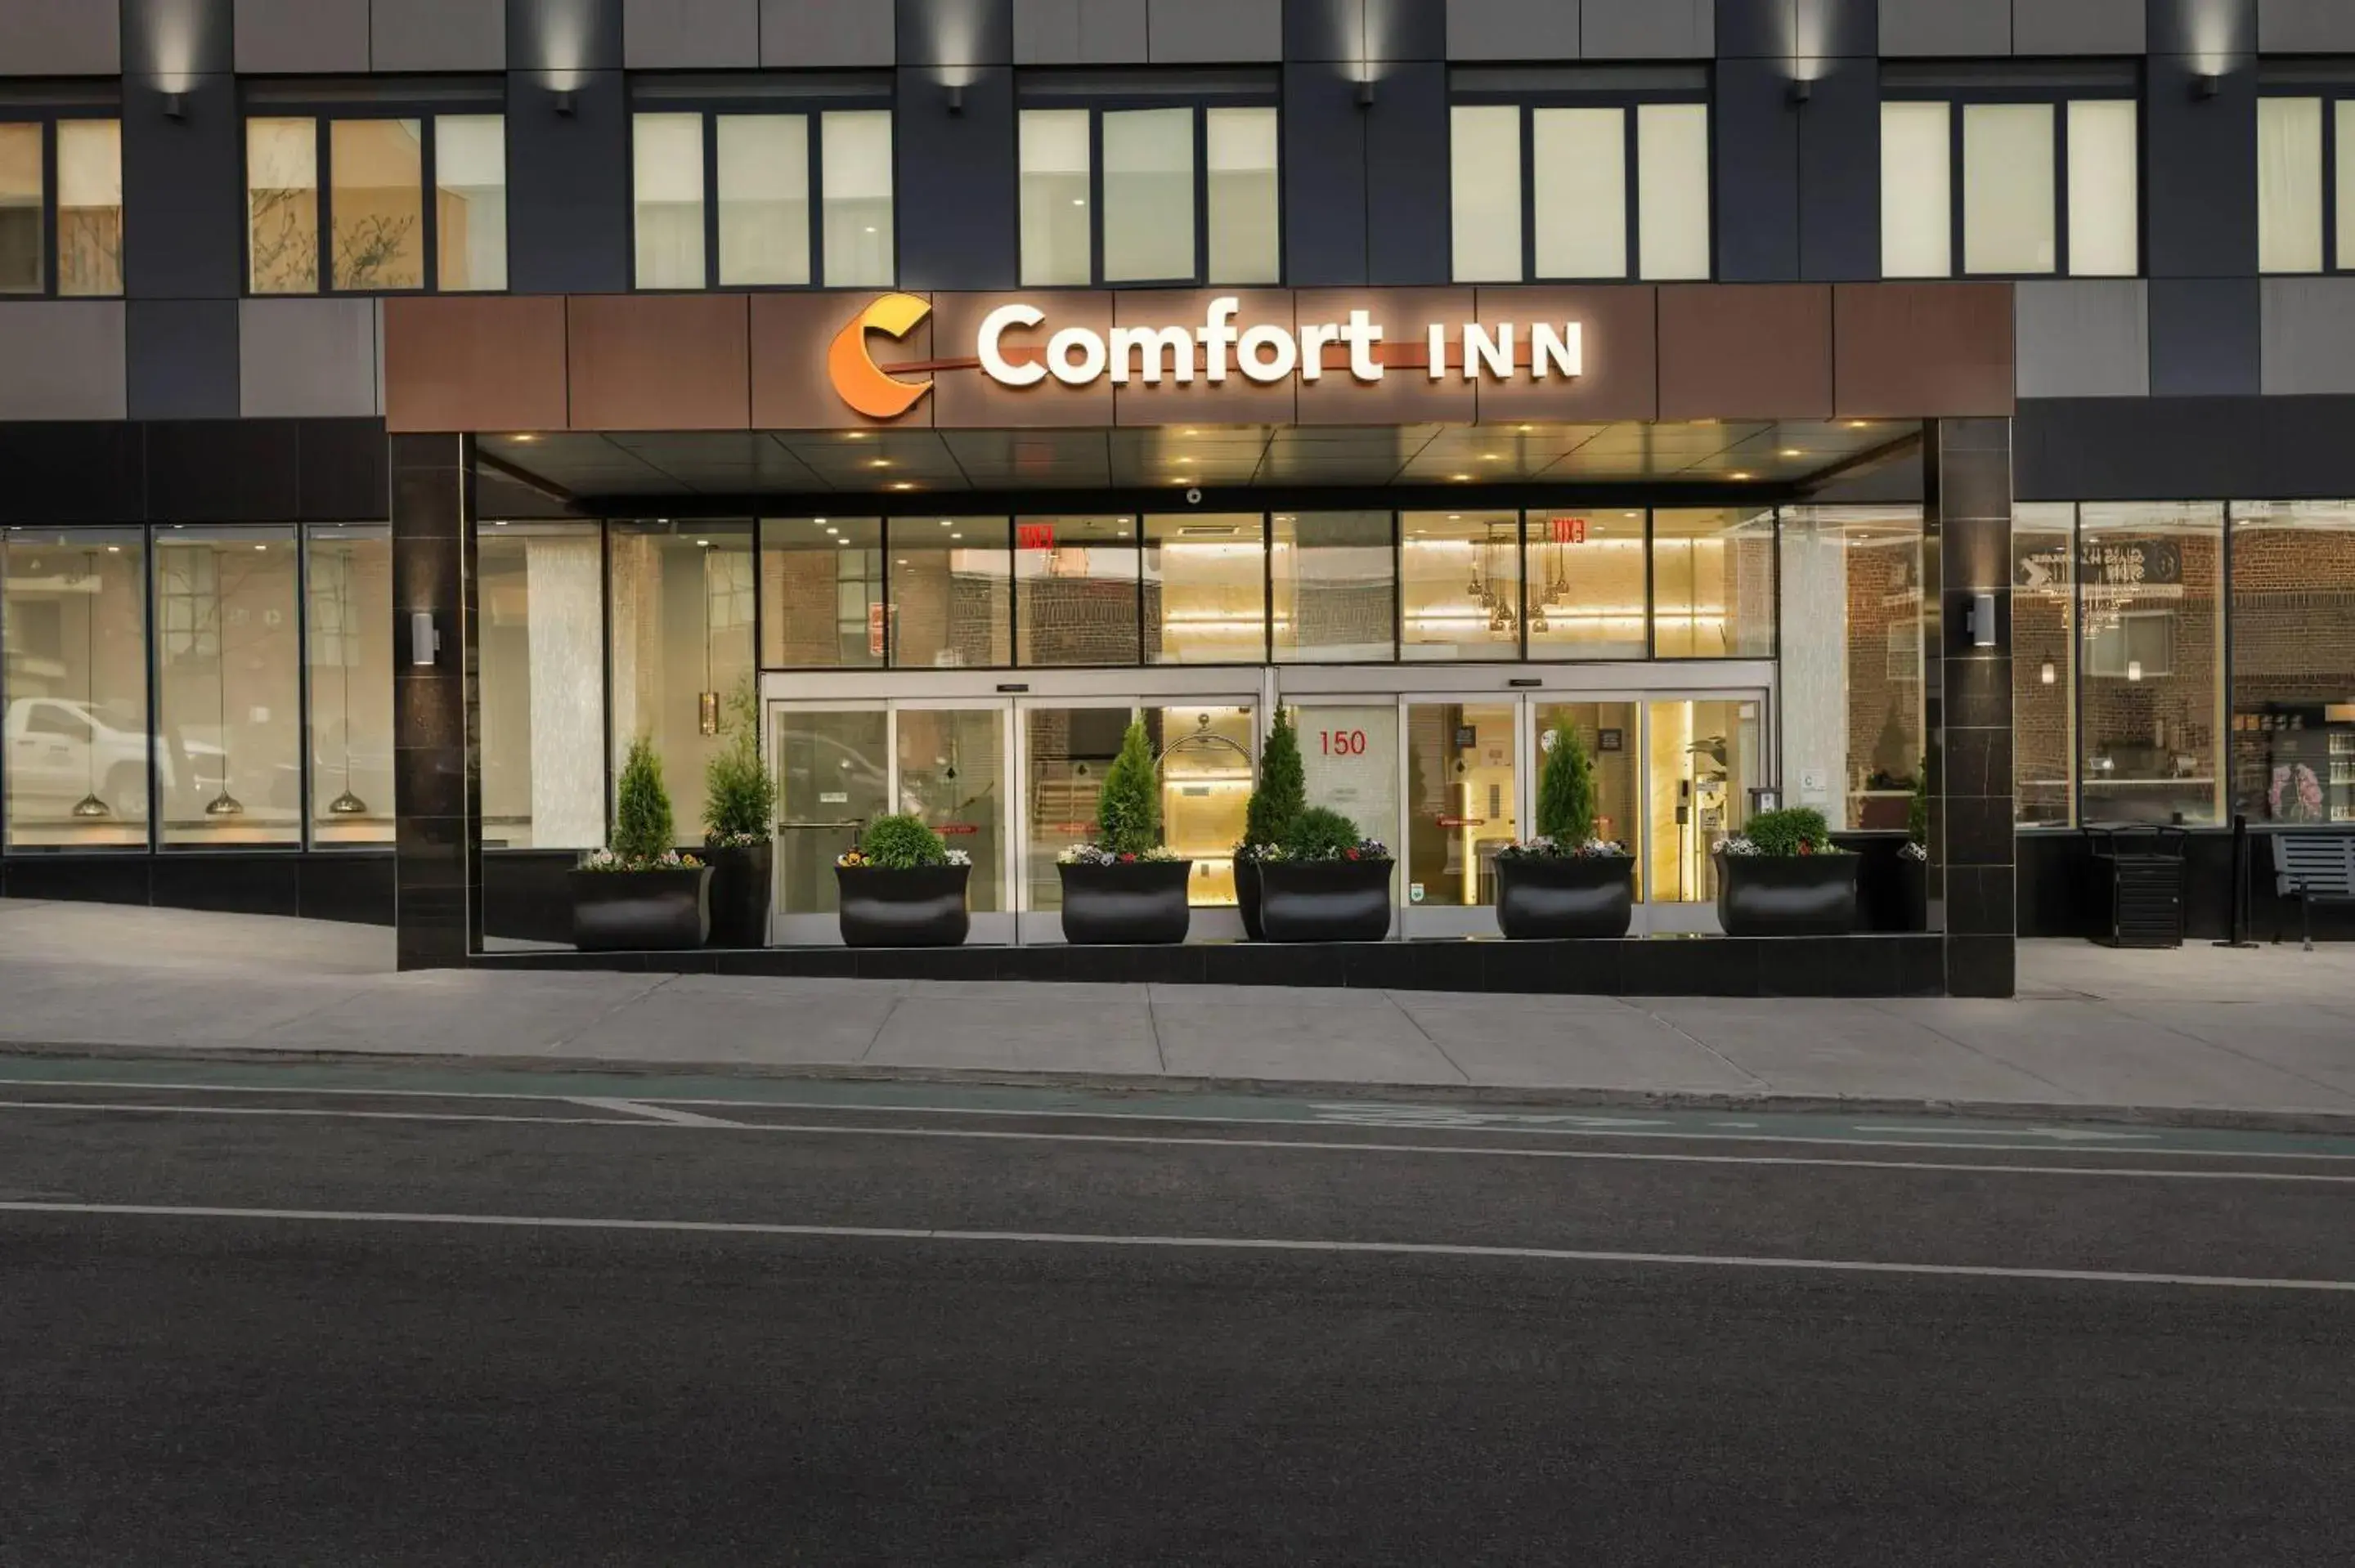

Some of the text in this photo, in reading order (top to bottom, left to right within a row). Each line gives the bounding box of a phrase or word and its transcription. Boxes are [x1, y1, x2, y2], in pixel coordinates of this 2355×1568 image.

[978, 297, 1581, 386] Comfort INN
[1320, 731, 1366, 755] 150
